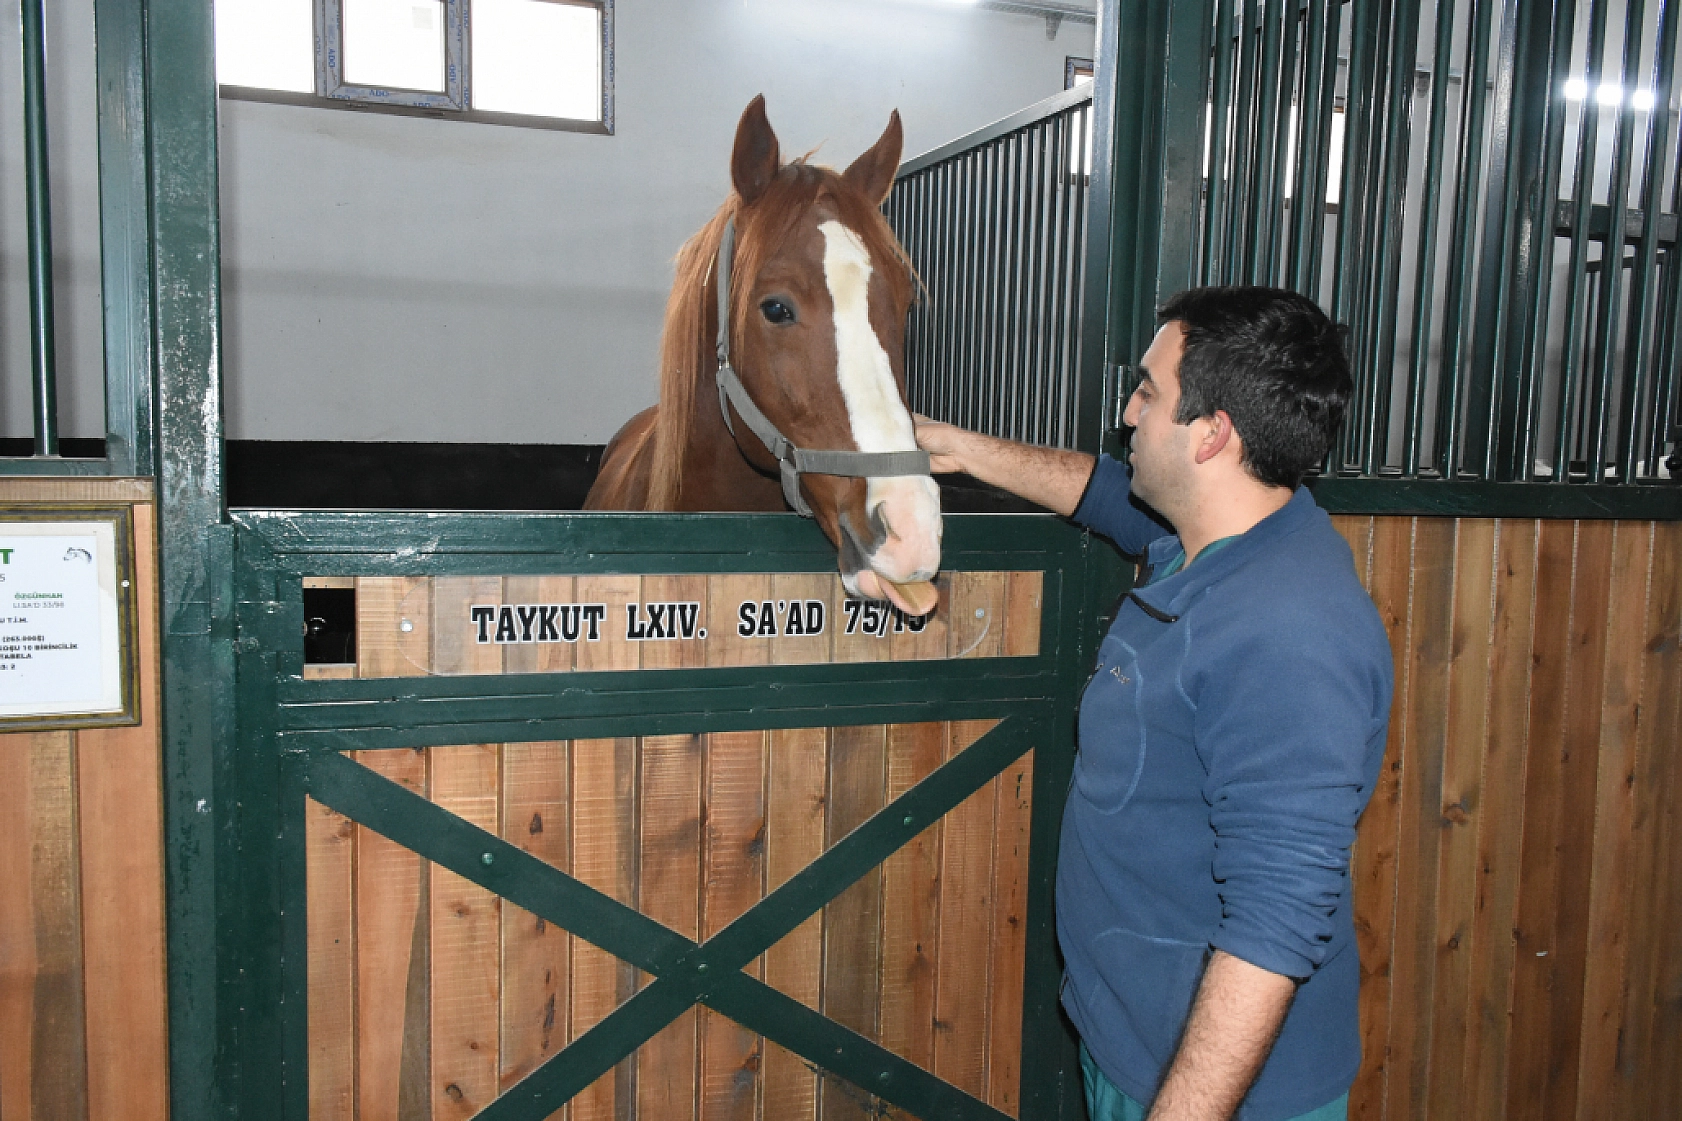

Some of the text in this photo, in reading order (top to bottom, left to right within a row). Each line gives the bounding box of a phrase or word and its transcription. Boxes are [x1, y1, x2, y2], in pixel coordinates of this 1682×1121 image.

[328, 48, 336, 68] ADO
[369, 89, 390, 98] ADO
[471, 603, 606, 644] TAYKUT
[626, 602, 708, 641] LXIV.
